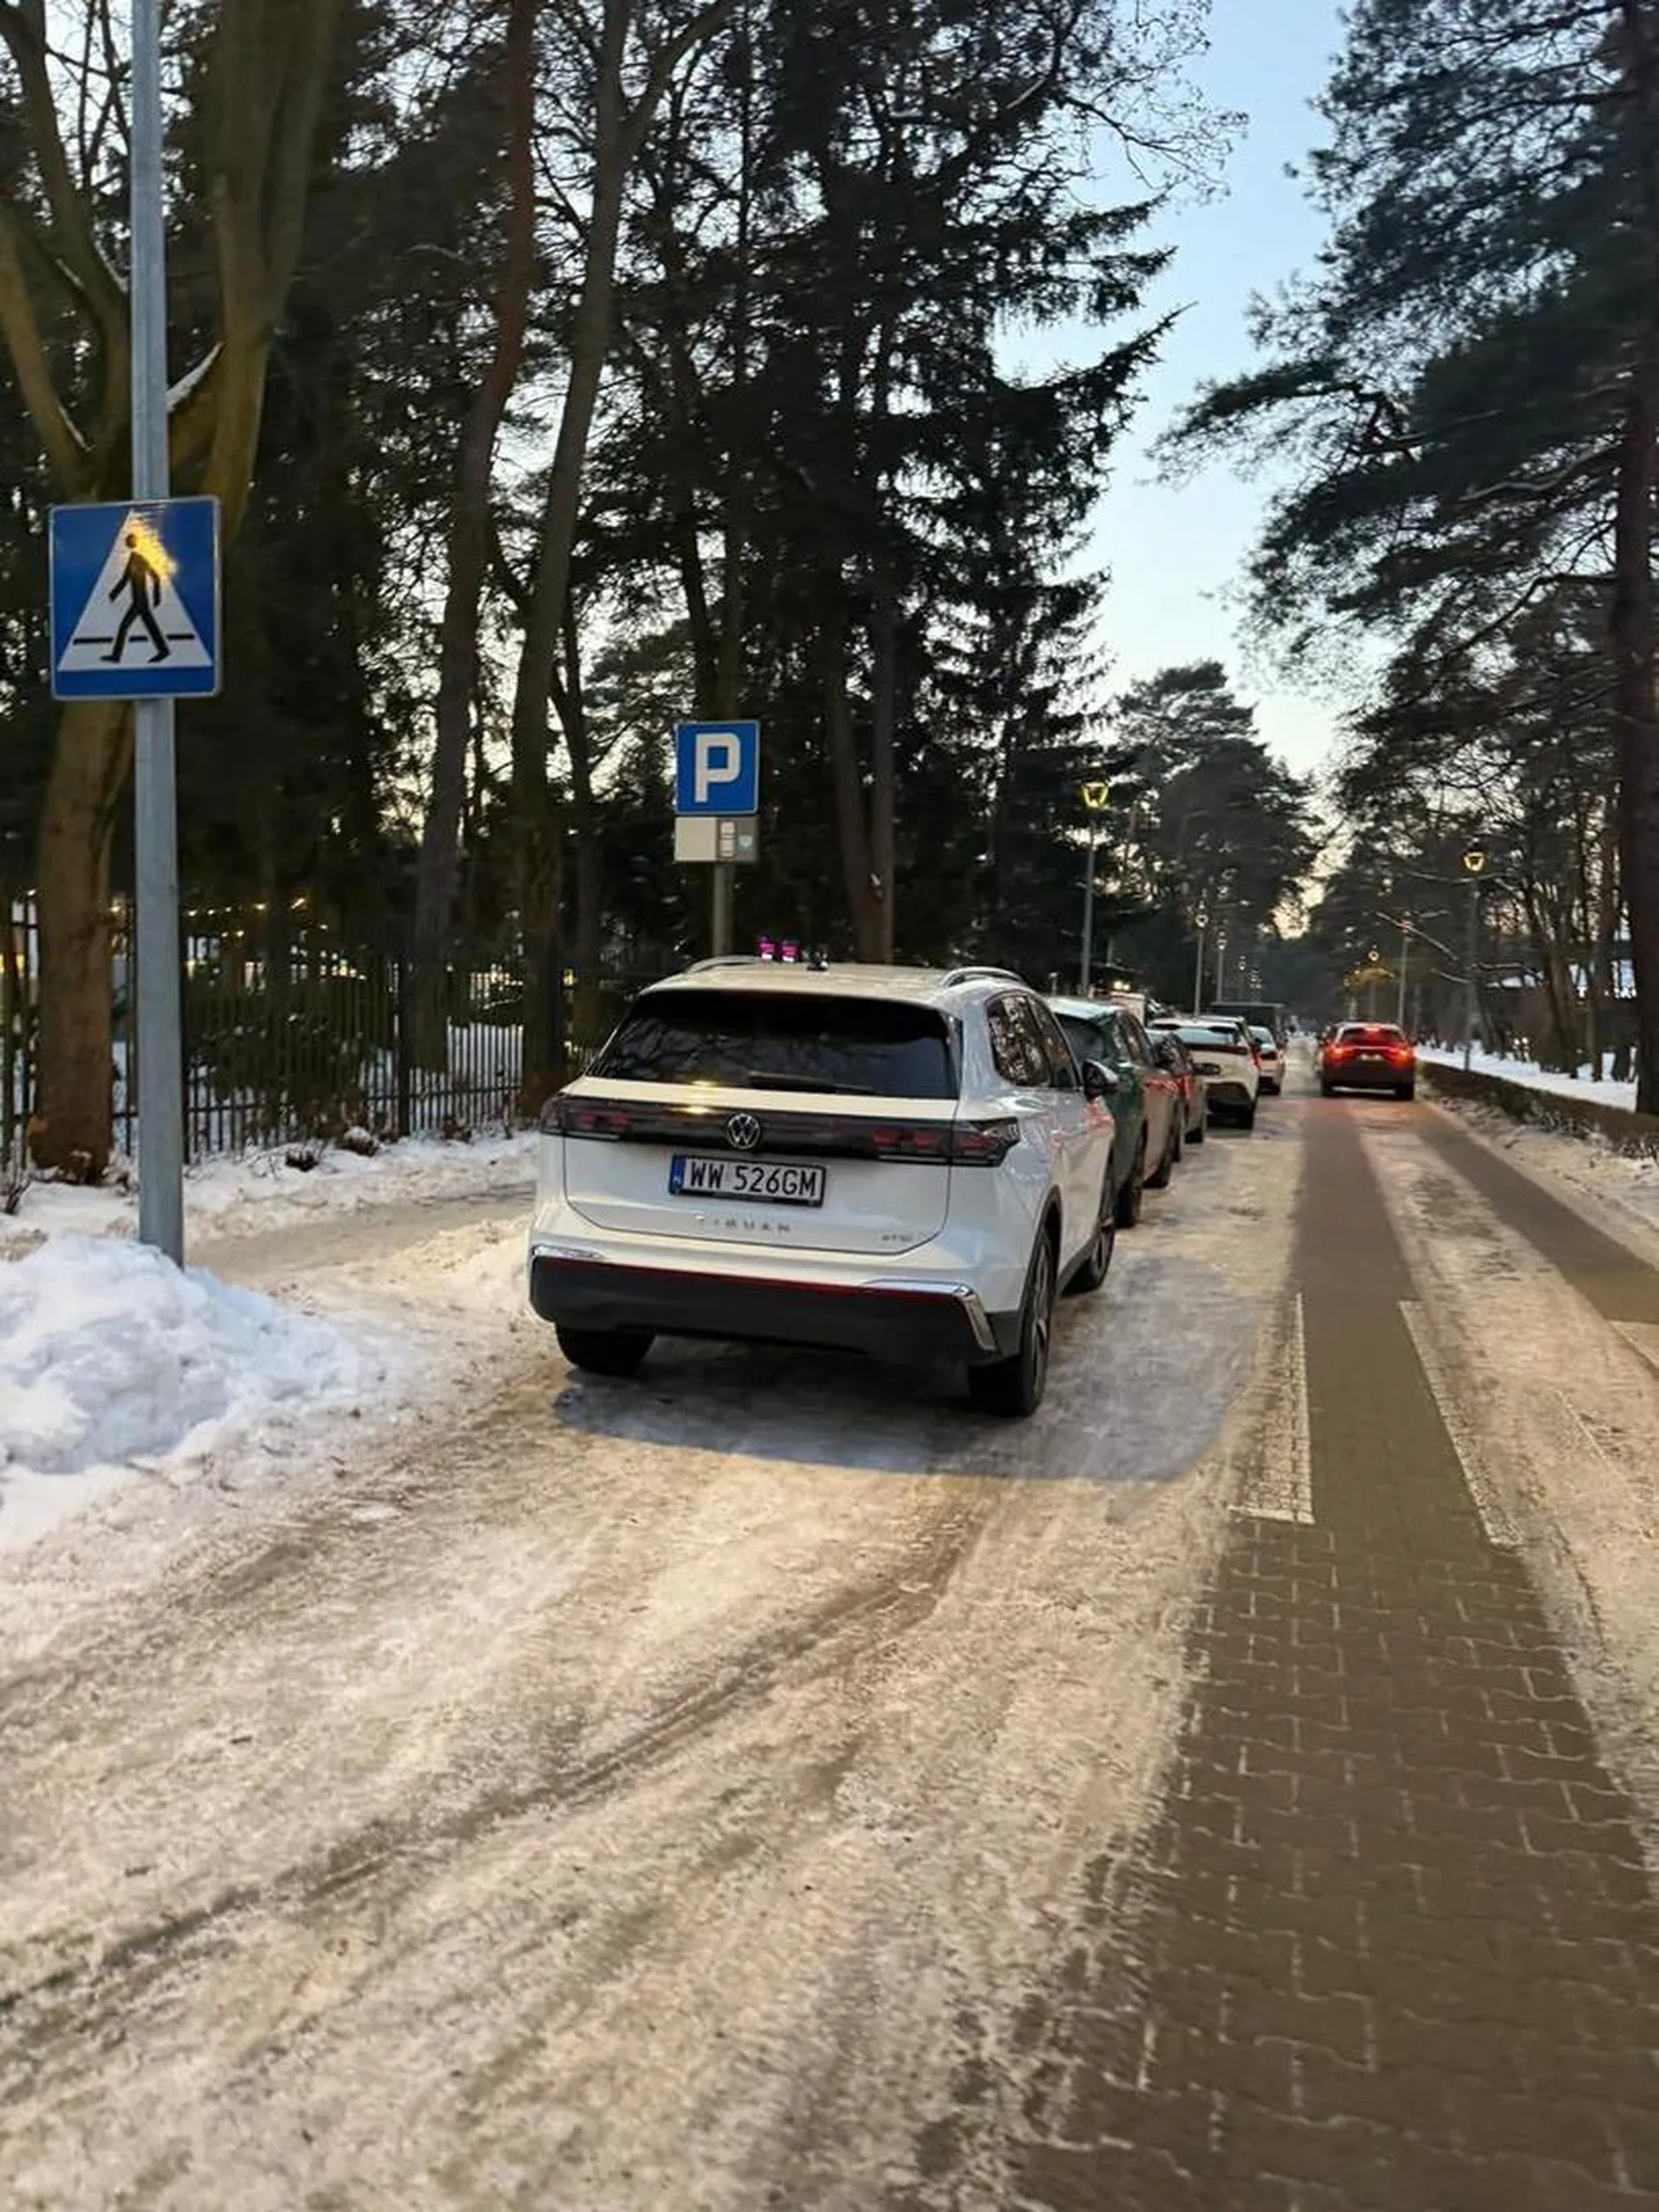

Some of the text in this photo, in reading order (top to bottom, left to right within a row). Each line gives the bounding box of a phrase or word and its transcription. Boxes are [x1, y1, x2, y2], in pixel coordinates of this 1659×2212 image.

[695, 733, 741, 803] P
[690, 1161, 817, 1197] WW 526GM
